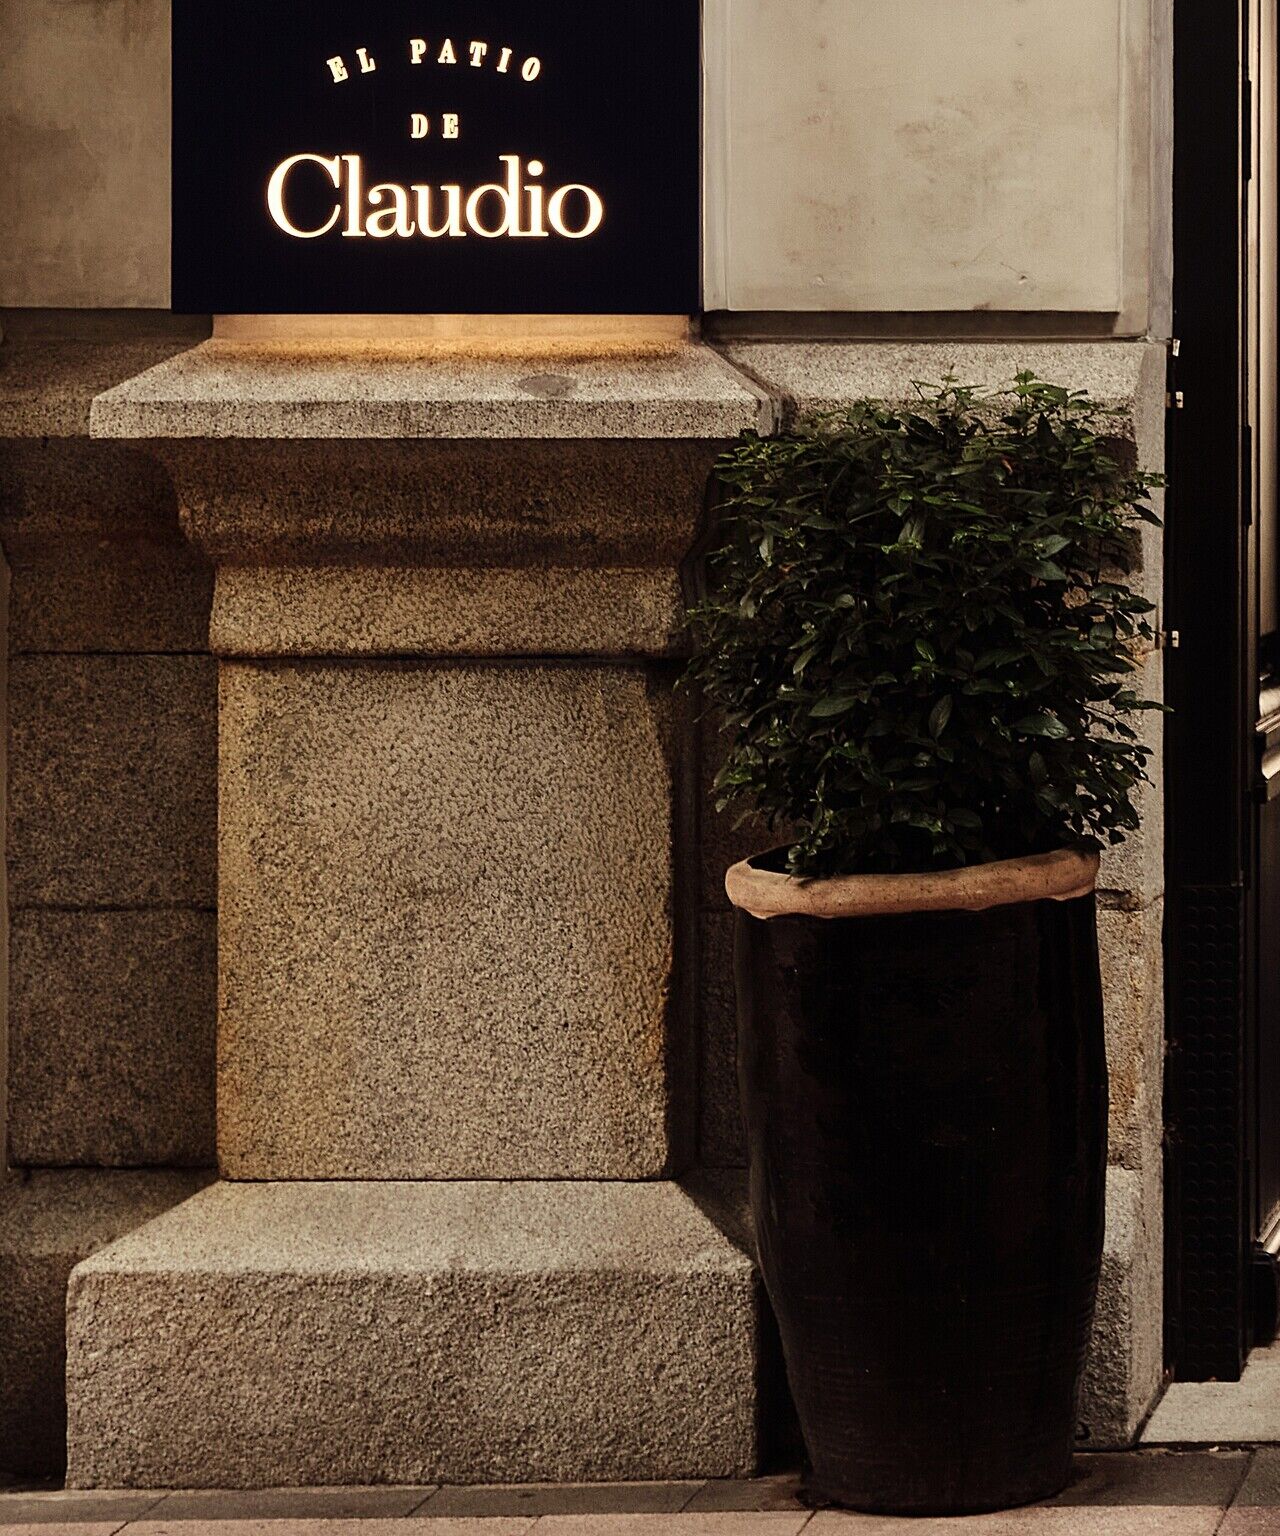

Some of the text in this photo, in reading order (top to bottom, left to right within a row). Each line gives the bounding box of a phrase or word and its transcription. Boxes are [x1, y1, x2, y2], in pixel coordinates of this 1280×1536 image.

[326, 38, 542, 84] EL PATIO
[410, 113, 459, 139] DE
[266, 153, 605, 239] Claudio
